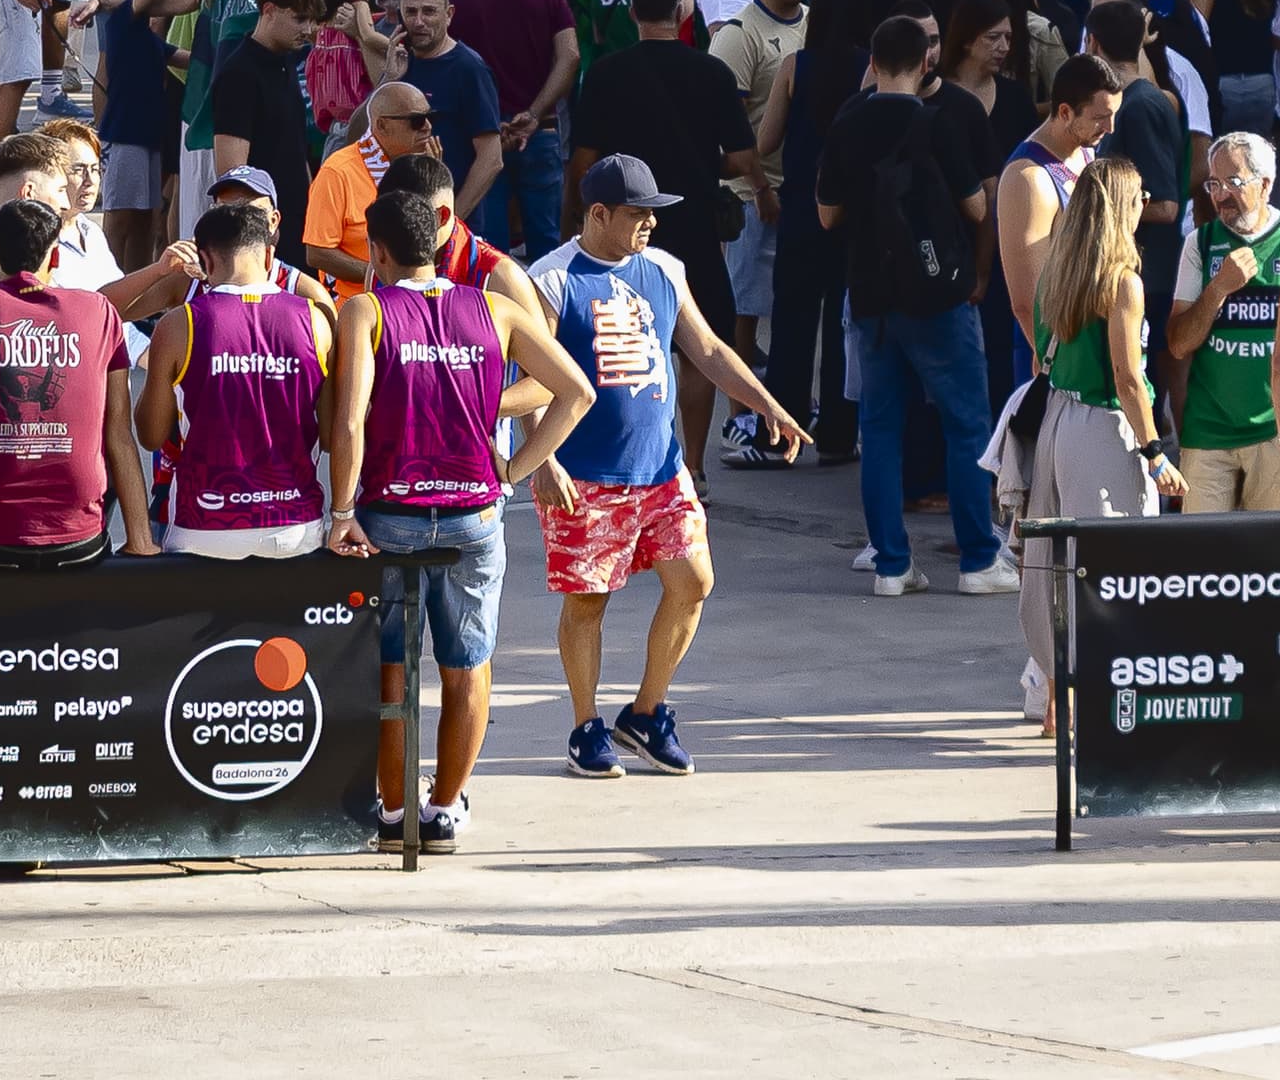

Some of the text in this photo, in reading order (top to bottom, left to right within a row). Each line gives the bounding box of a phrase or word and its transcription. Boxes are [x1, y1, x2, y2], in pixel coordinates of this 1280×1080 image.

[20, 422, 68, 436] SUPPORTERS
[414, 479, 489, 493] COSEHISA
[229, 488, 301, 503] COSEHISA
[304, 603, 354, 624] acb
[1111, 655, 1215, 686] asisa
[54, 697, 122, 722] pelayo
[182, 699, 305, 722] supercopa
[1144, 696, 1233, 720] JOVENTUT
[192, 718, 304, 745] endesa
[40, 752, 76, 762] LOTUS
[215, 767, 289, 780] Badalona'26
[88, 782, 137, 794] ONEBOX
